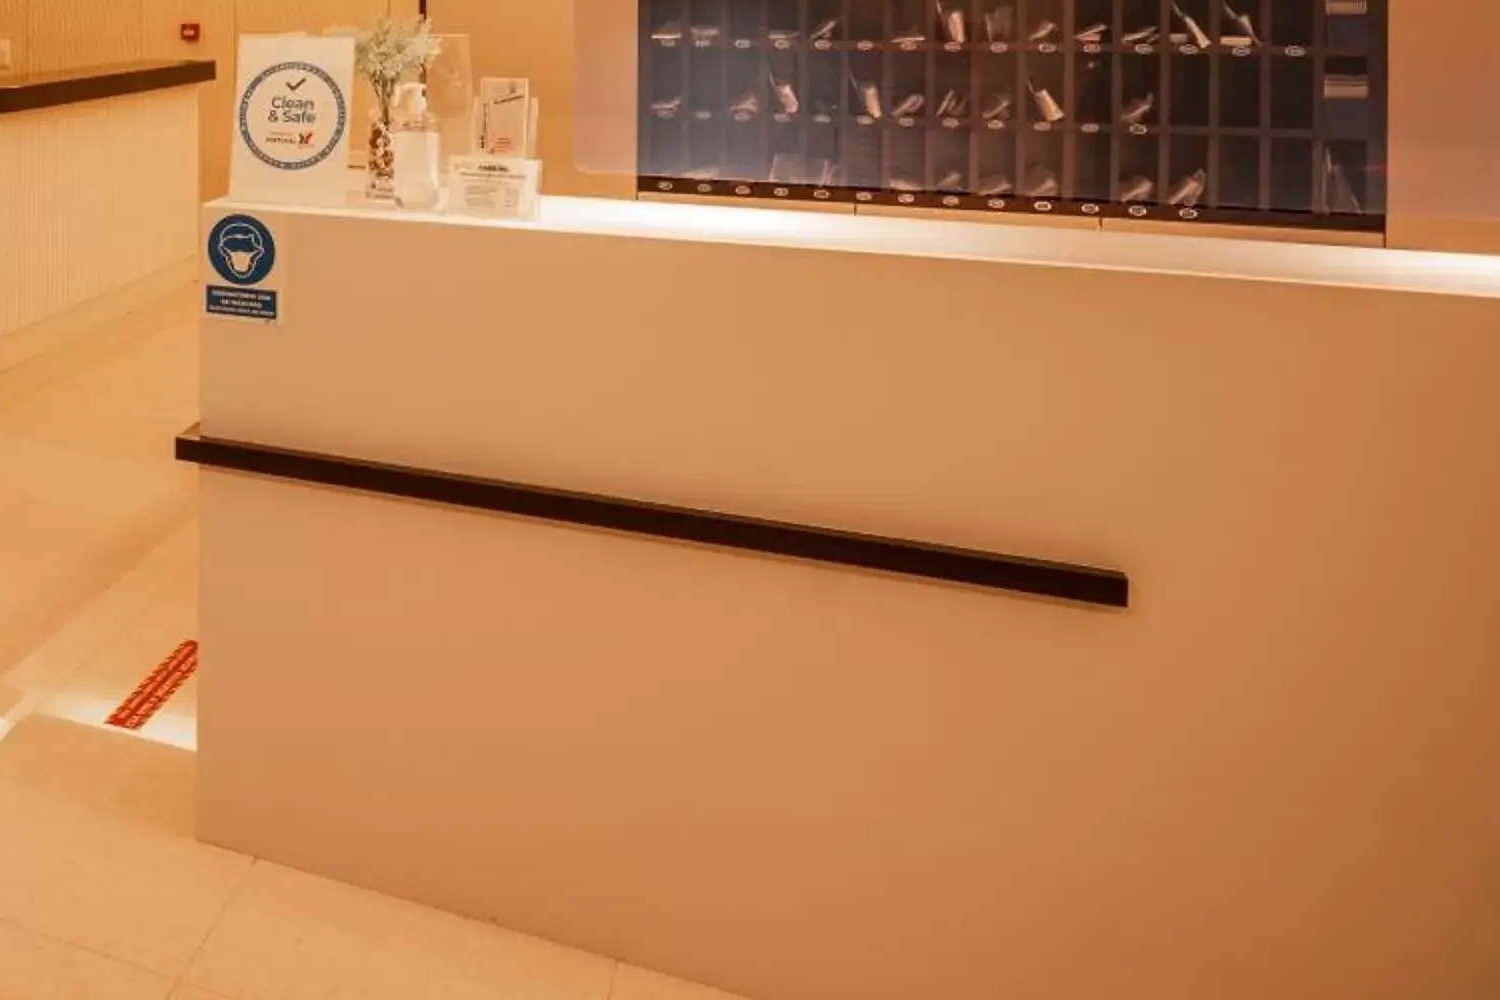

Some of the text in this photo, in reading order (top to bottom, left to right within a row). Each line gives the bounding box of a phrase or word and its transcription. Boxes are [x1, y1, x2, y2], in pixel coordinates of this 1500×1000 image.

[271, 95, 315, 110] Clean
[267, 109, 316, 124] & Safe
